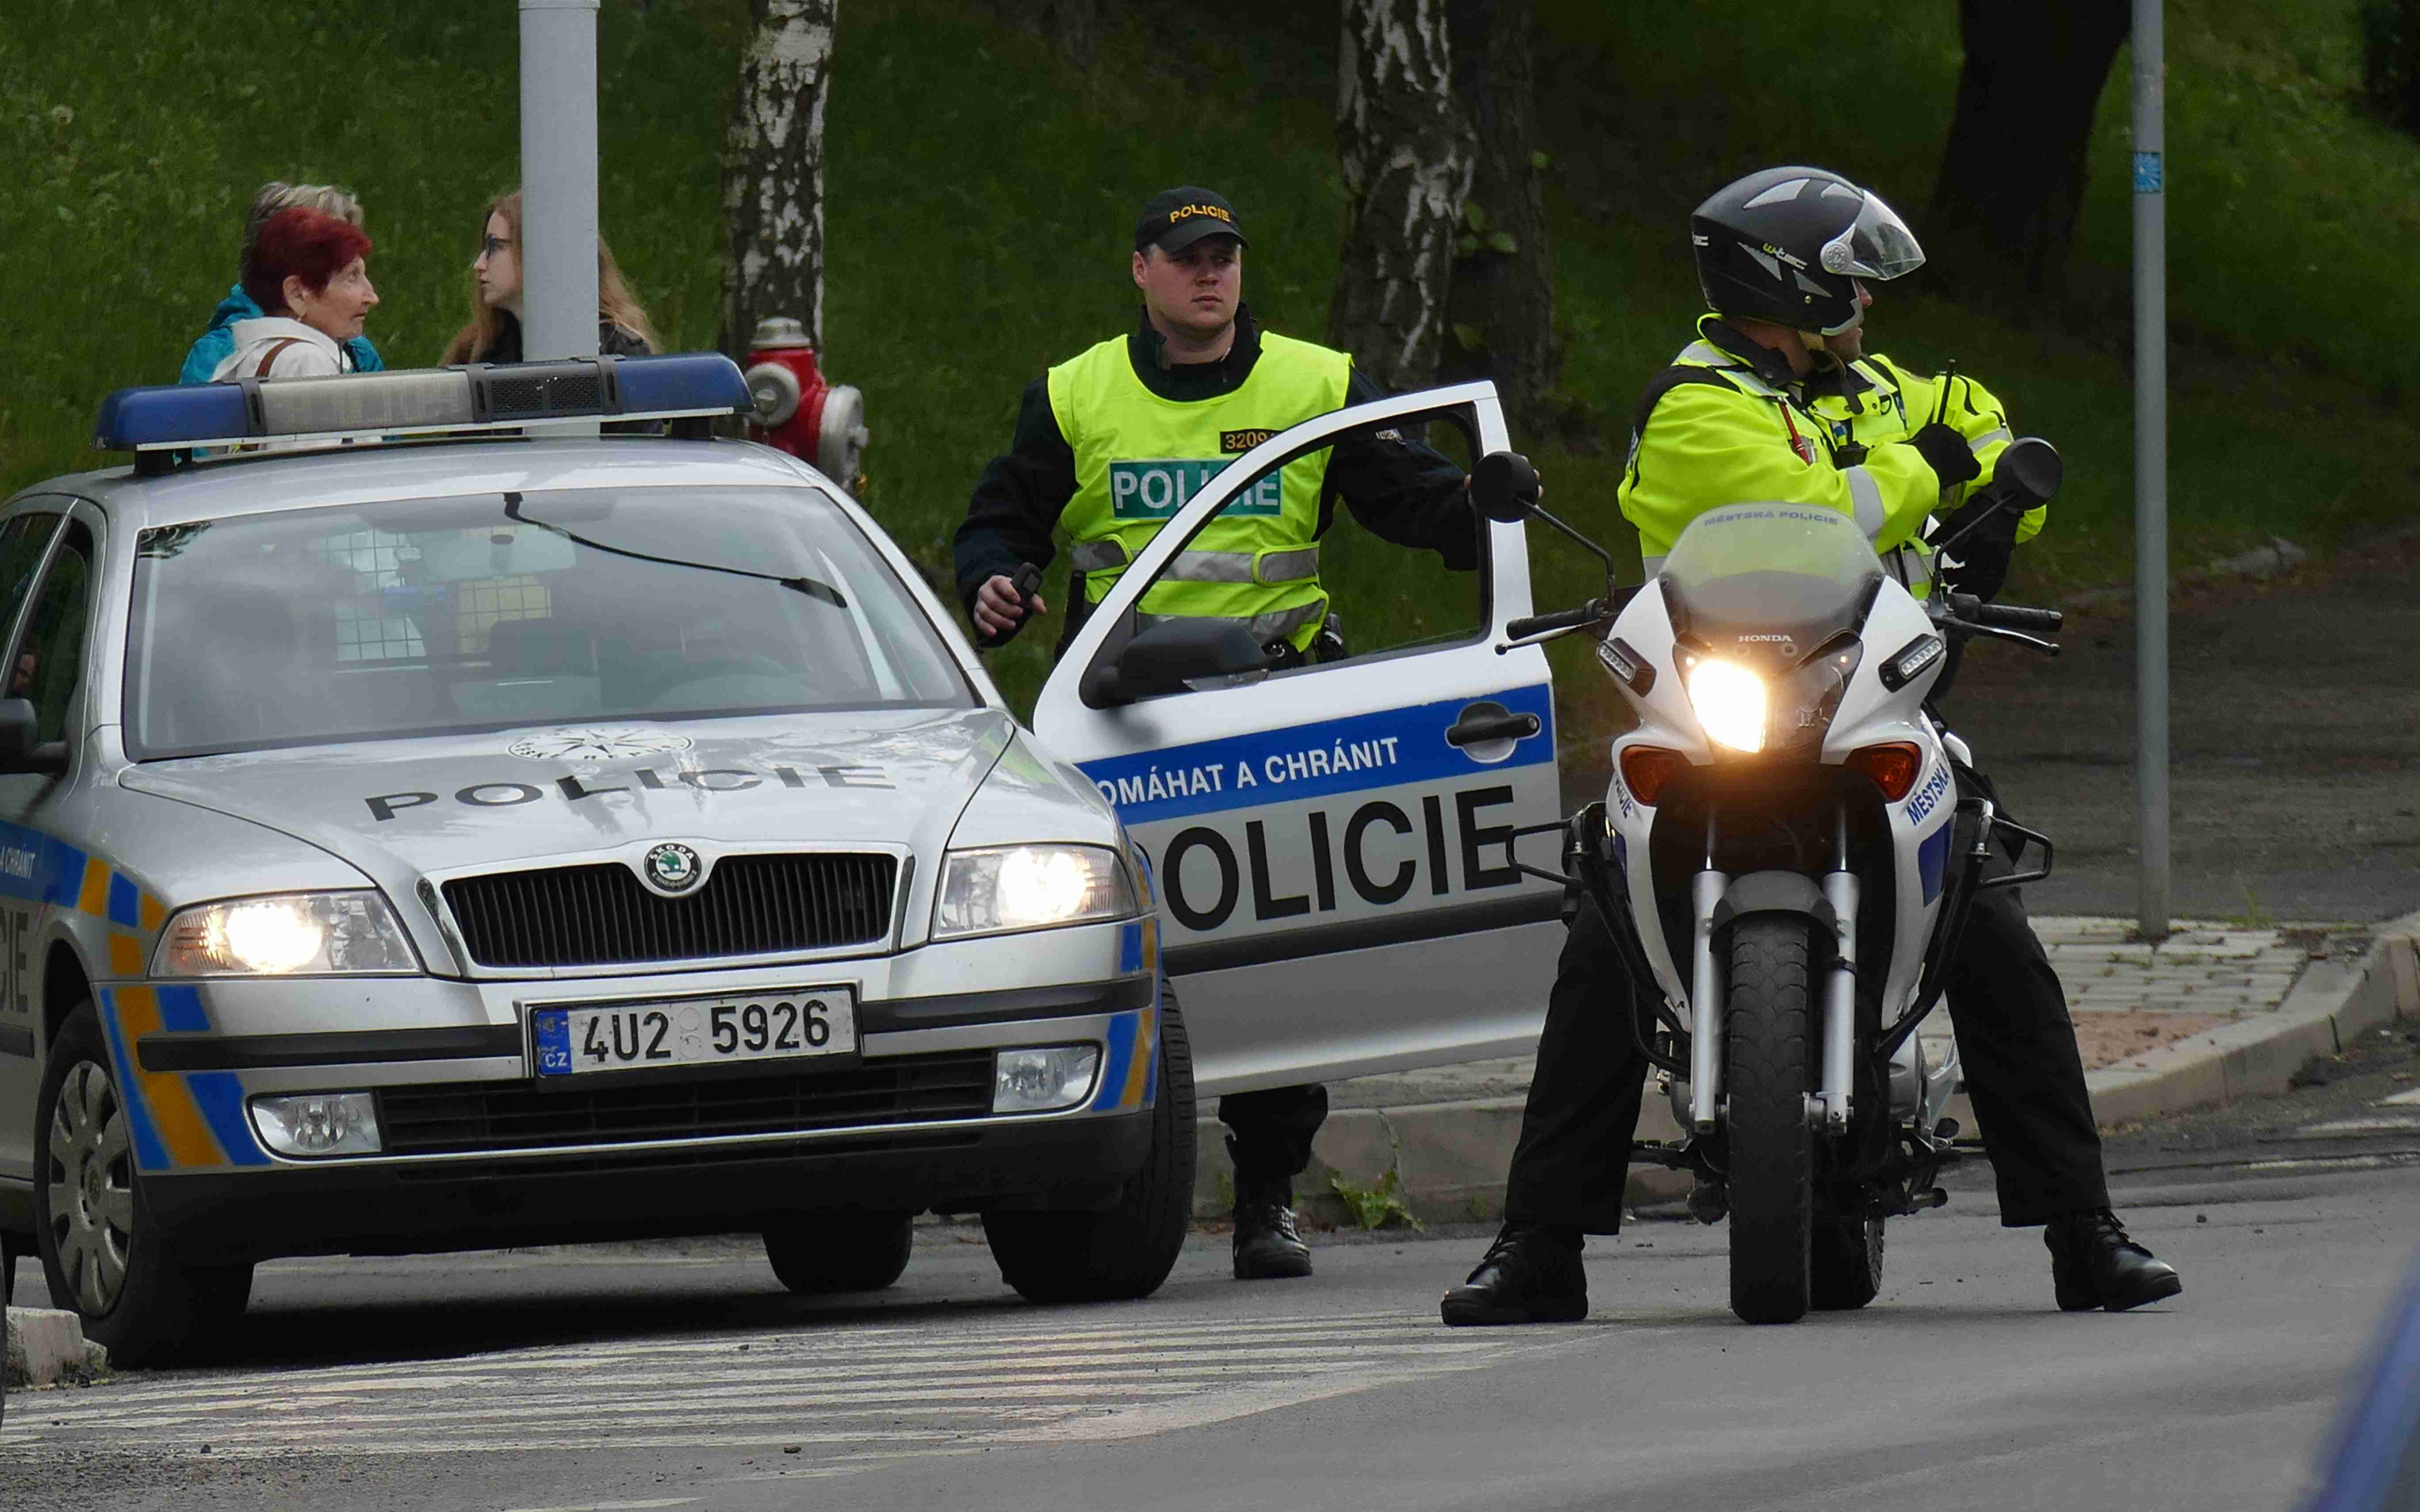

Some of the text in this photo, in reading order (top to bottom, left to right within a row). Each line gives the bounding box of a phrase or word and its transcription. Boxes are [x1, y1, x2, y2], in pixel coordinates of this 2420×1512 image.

[1170, 204, 1230, 223] POLICIE
[1225, 431, 1275, 449] 3209
[1779, 511, 1838, 525] POLICIE
[1738, 634, 1794, 642] HONDA
[1097, 737, 1398, 806] OMÁHAT A CHRÁNIT
[364, 766, 897, 821] POLICIE
[1133, 785, 1522, 931] OLICIE
[583, 999, 830, 1062] 4U2 5926
[545, 1052, 568, 1068] CZ
